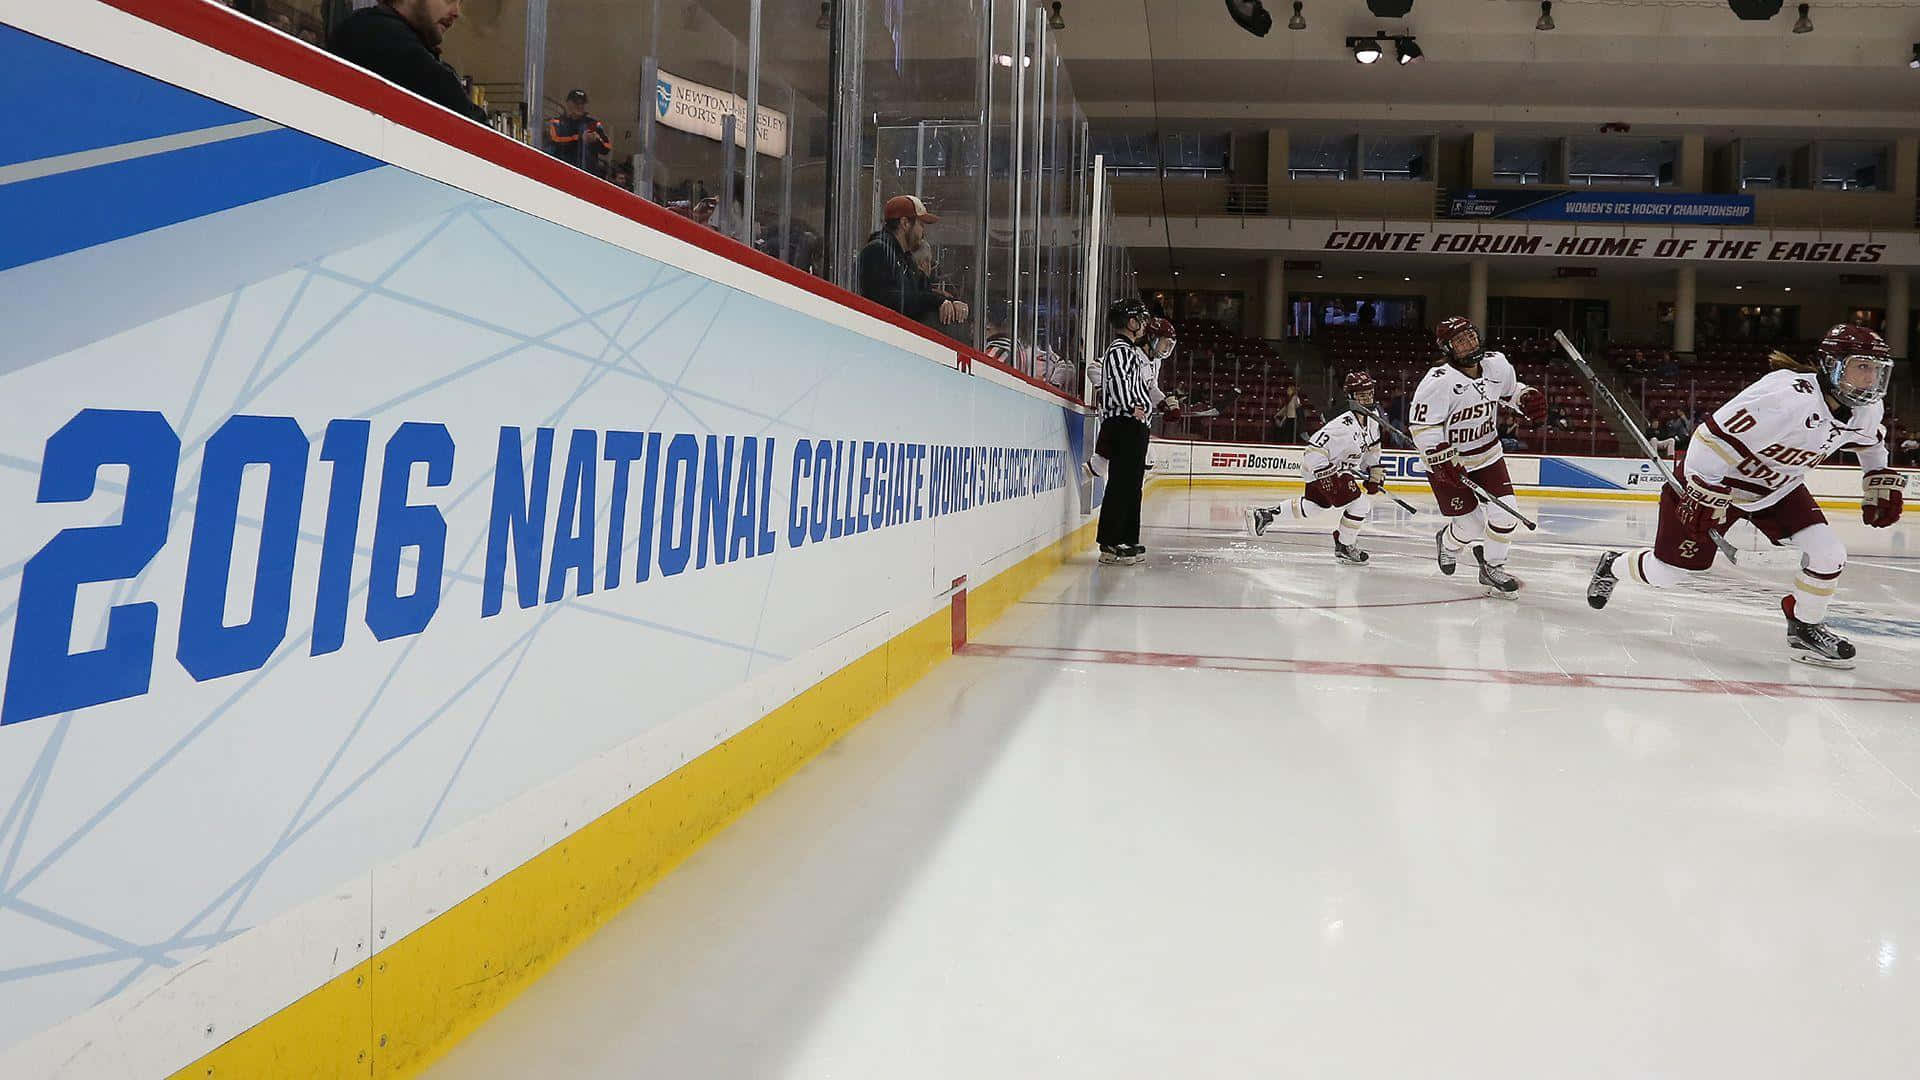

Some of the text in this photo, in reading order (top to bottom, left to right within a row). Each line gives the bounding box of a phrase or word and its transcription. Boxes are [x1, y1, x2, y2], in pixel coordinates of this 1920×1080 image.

[675, 102, 717, 124] SPORTS
[1565, 202, 1750, 217] WOMEN'S ICE HOCKEY CHAMPIONSHIP
[1324, 231, 1424, 251] CONTE
[1431, 234, 1543, 254] FORUM
[1554, 236, 1647, 258] HOME
[1653, 238, 1698, 259] OF
[1703, 239, 1761, 260] THE
[1766, 241, 1887, 263] EAGLES
[1414, 403, 1428, 422] 12
[1723, 408, 1757, 434] 10
[1315, 431, 1330, 448] 13
[0, 408, 456, 726] 2016
[480, 426, 777, 618] NATIONAL
[787, 438, 927, 549] COLLEGIATE
[928, 444, 987, 519] WOMEN'S
[987, 446, 1003, 505] ICE
[1003, 447, 1033, 501] HOCKEY
